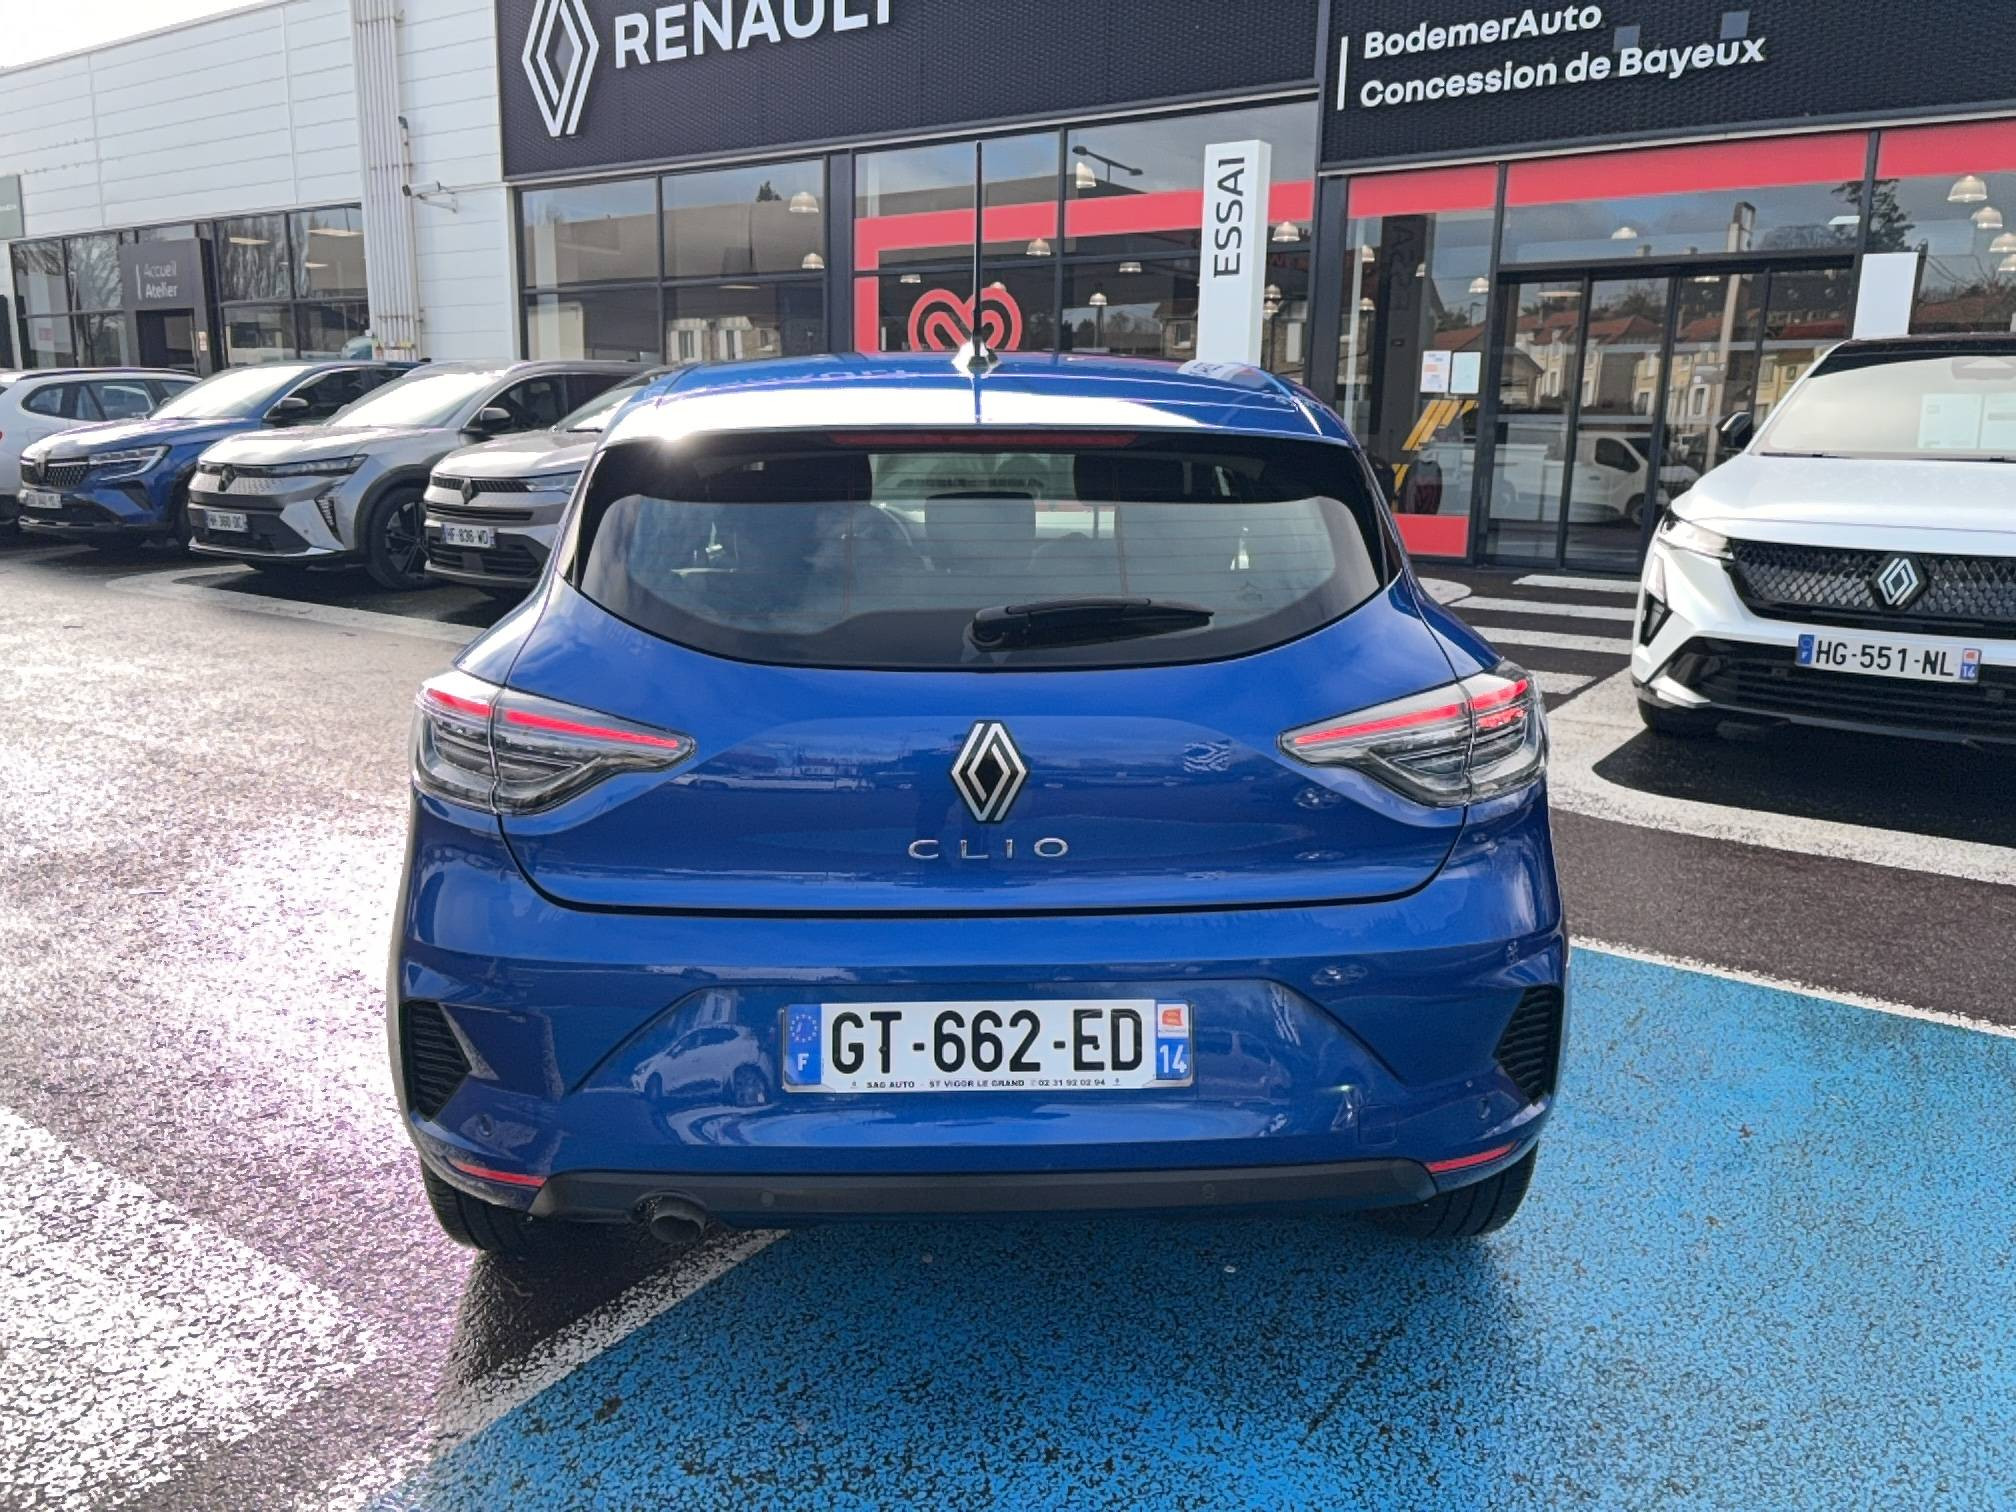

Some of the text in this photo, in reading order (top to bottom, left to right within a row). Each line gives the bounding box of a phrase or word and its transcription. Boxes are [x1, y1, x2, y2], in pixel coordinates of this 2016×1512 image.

[1363, 4, 1603, 59] BodemerAuto
[1360, 37, 1767, 107] Concession de Bayeux
[1213, 156, 1245, 279] ESSAI
[145, 281, 179, 299] Atelier
[1815, 640, 1954, 677] HG-551-NL
[908, 837, 1069, 860] CLIO
[831, 1008, 1143, 1075] GT-662-ED
[797, 1053, 809, 1072] F
[1159, 1044, 1188, 1074] 14
[890, 1080, 915, 1089] AUTO
